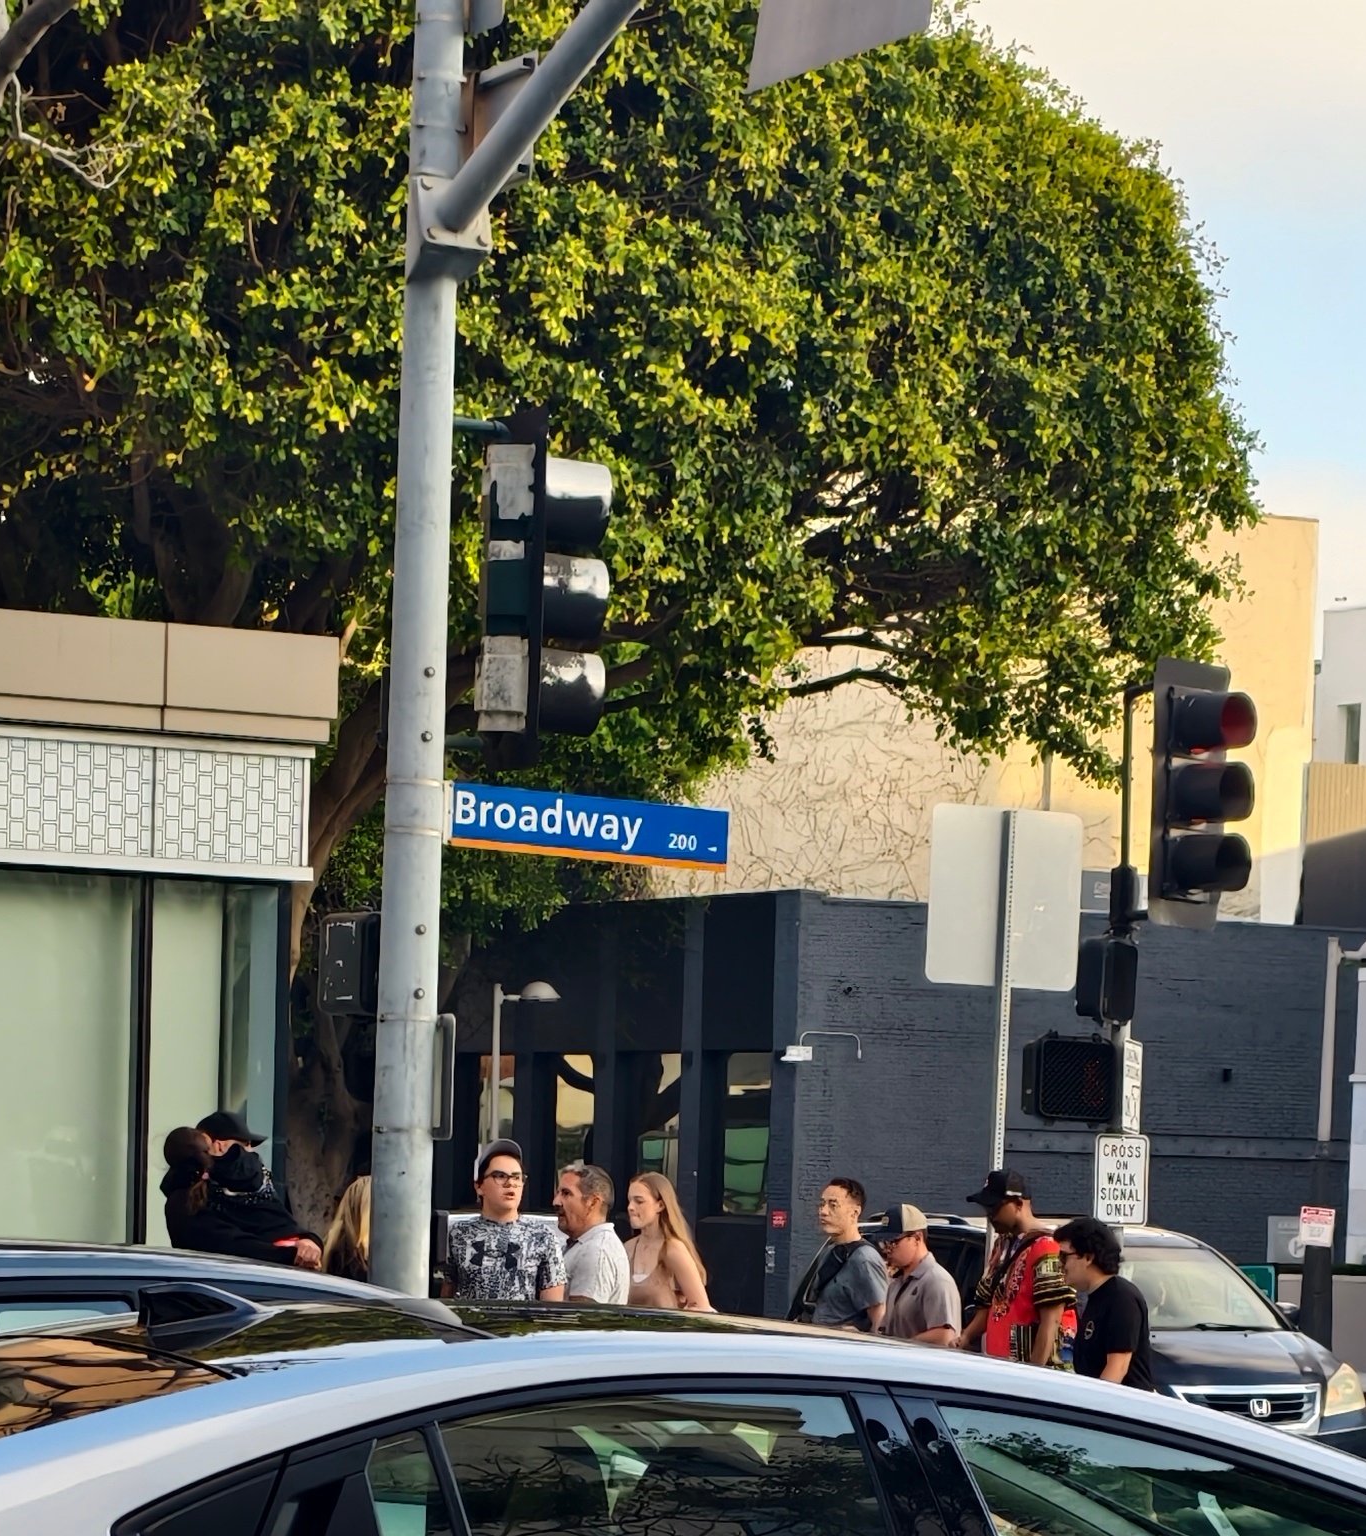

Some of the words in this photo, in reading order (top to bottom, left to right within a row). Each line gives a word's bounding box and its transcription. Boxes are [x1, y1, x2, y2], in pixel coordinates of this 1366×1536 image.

[454, 790, 643, 852] Broadway
[668, 833, 698, 852] 200
[1103, 1143, 1142, 1158] CROSS
[1115, 1160, 1128, 1170] ON
[1107, 1172, 1136, 1187] WALK
[1100, 1187, 1142, 1202] SIGNAL
[1106, 1203, 1136, 1217] ONLY
